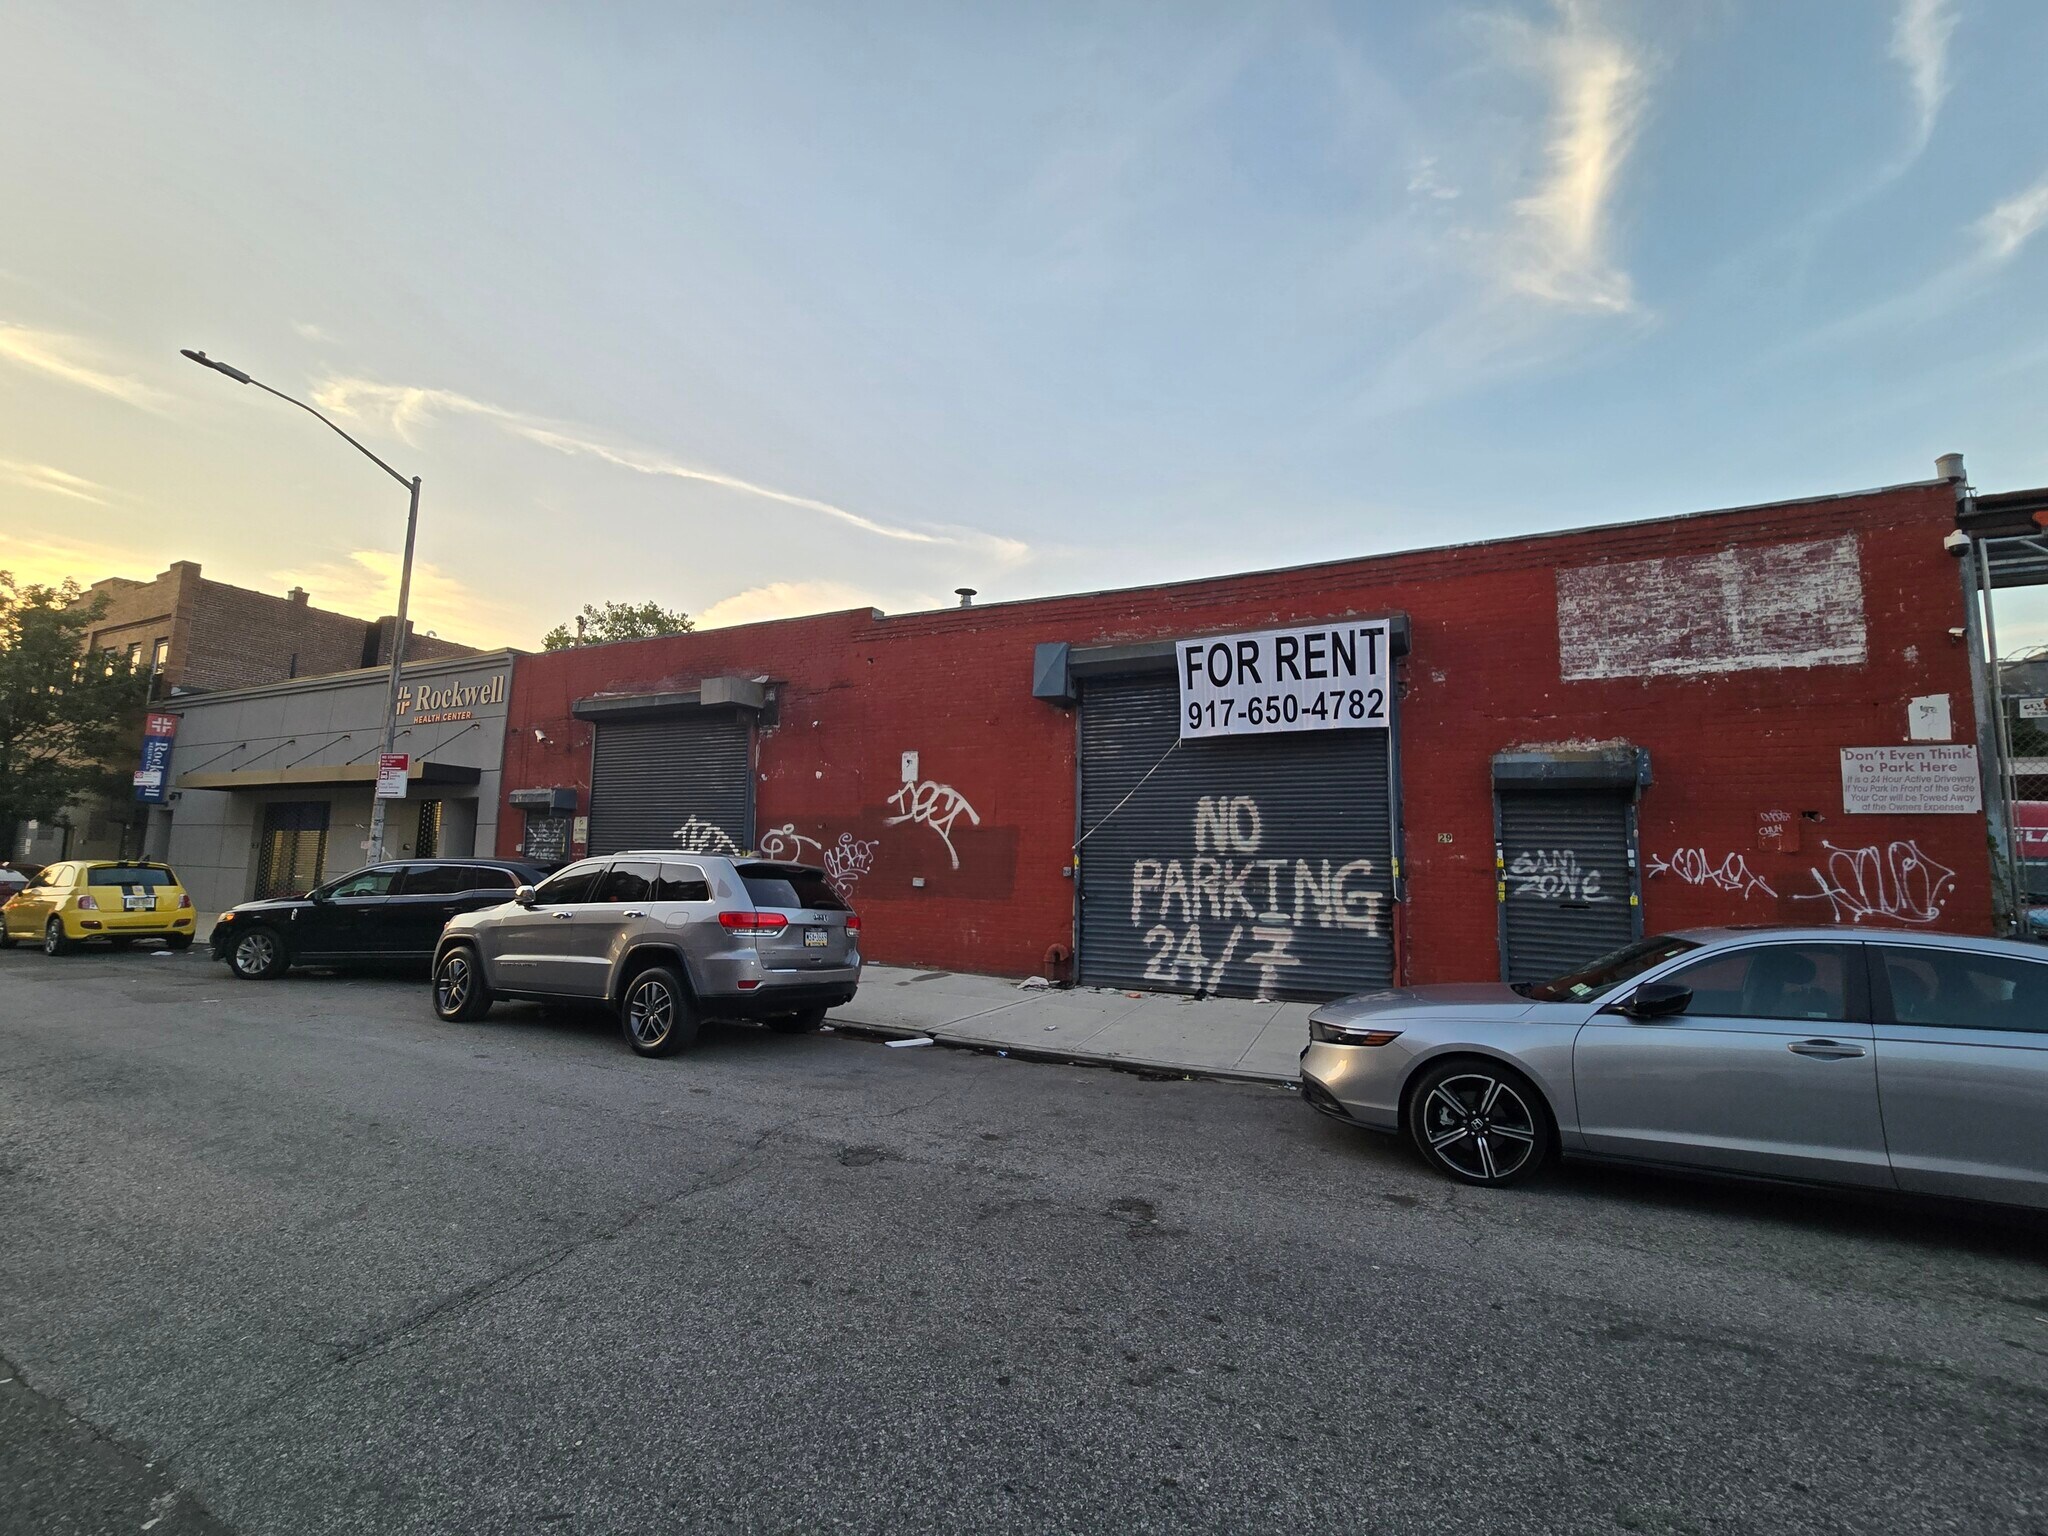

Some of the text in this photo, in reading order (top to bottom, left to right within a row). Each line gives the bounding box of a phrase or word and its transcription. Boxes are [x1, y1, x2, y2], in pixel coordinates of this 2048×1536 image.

[1185, 627, 1384, 690] FOR RENT
[414, 675, 505, 711] Rockwell
[1188, 688, 1384, 730] 917-650-4782
[413, 711, 472, 724] HEALTH CENTER
[1845, 748, 1972, 760] Don't Even Think
[1859, 761, 1957, 773] to Park Here
[1847, 775, 1853, 783] It
[1854, 776, 1861, 784] is
[1882, 775, 1901, 783] Hour
[1905, 775, 1931, 783] Active
[1934, 775, 1976, 784] Driveway
[1845, 785, 1850, 793] If
[1853, 785, 1868, 793] You
[1870, 785, 1888, 793] Park
[1901, 784, 1921, 792] Front
[1923, 784, 1934, 792] of
[1935, 784, 1949, 792] the
[1952, 784, 1975, 792] Gate
[1850, 794, 1869, 802] Your
[1889, 793, 1903, 801] will
[1905, 793, 1917, 801] be
[1920, 793, 1948, 801] Towed
[1950, 793, 1975, 802] Away
[1872, 803, 1886, 811] the
[1889, 803, 1921, 811] Owners
[1923, 803, 1965, 812] Expenses
[1194, 796, 1263, 852] NO
[1131, 859, 1384, 938] PARKING
[1143, 924, 1301, 1003] 24/7
